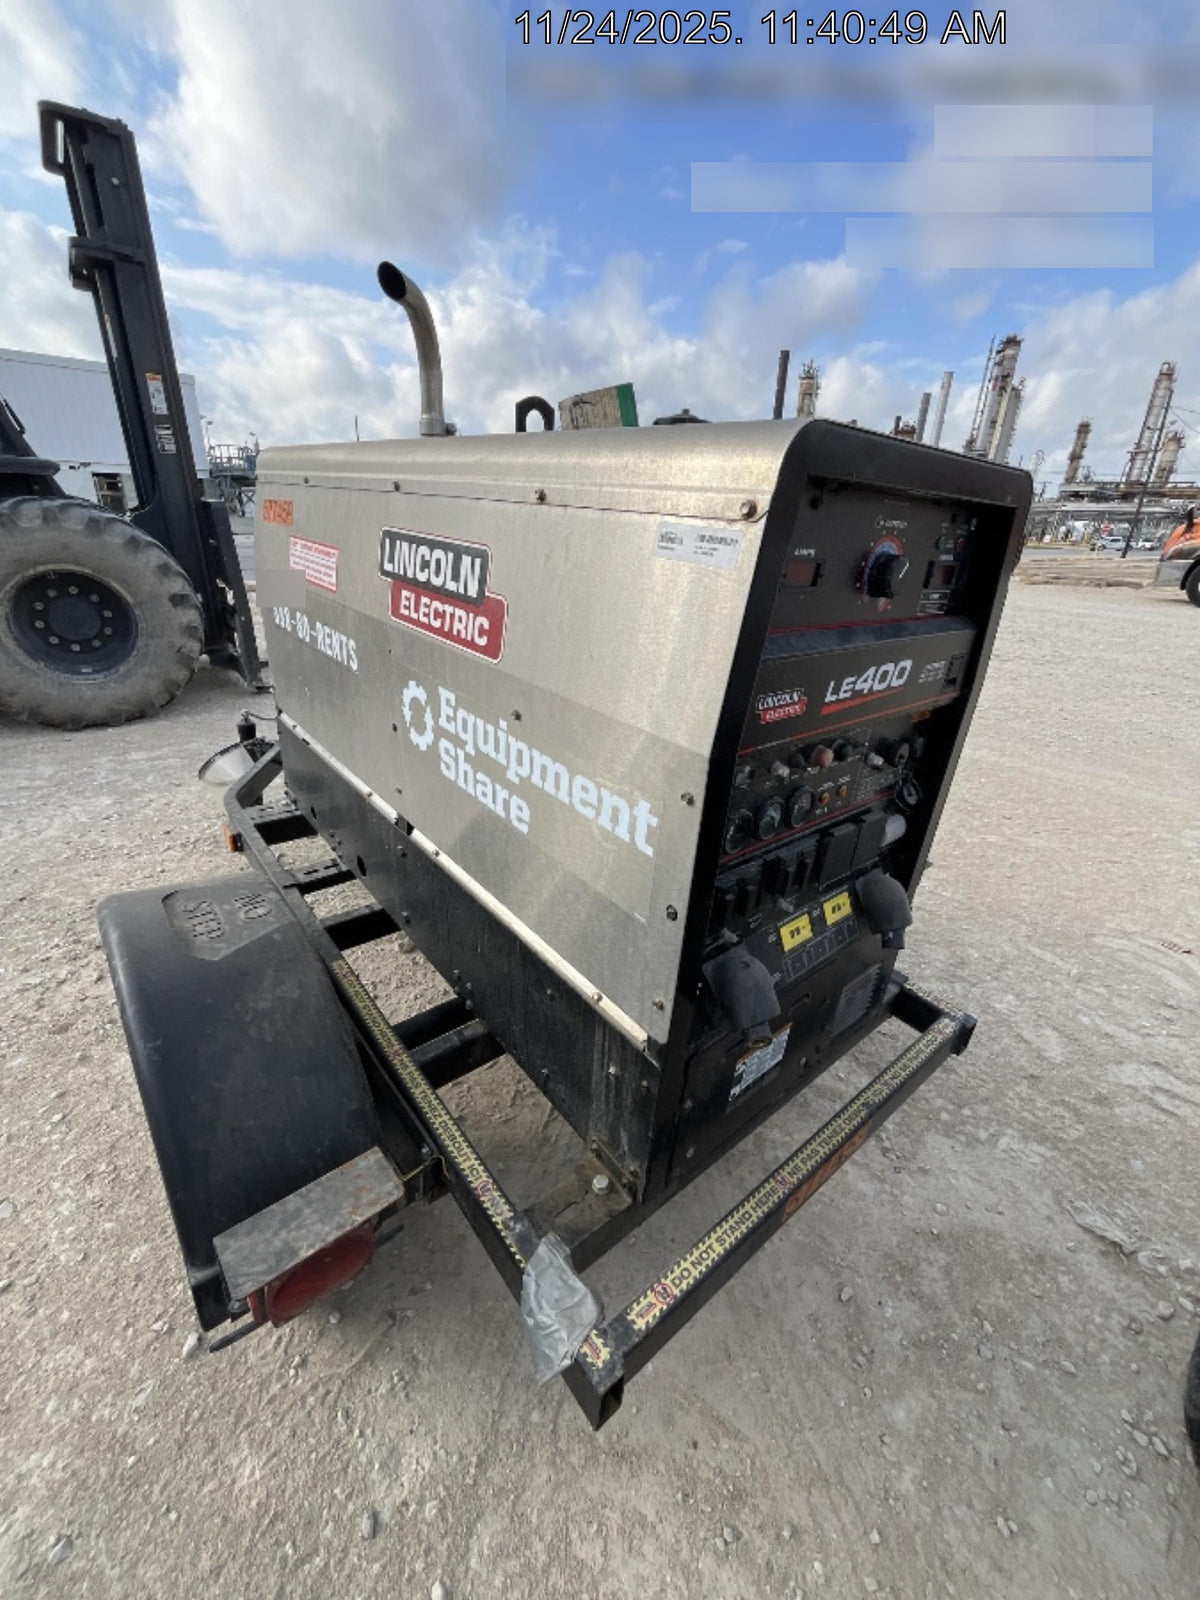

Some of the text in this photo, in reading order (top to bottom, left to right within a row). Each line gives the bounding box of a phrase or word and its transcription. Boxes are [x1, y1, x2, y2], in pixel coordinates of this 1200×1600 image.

[384, 537, 482, 598] LINCOLN
[399, 588, 490, 647] ELECTRIC
[825, 659, 912, 703] LE400
[438, 684, 659, 858] Equipment
[438, 737, 530, 835] Share
[181, 900, 226, 940] STEP
[234, 893, 273, 920] NO
[439, 1120, 472, 1165] DEBOUT
[467, 1164, 482, 1181] ICI
[671, 1186, 778, 1288] DO NOT STAND HERE
